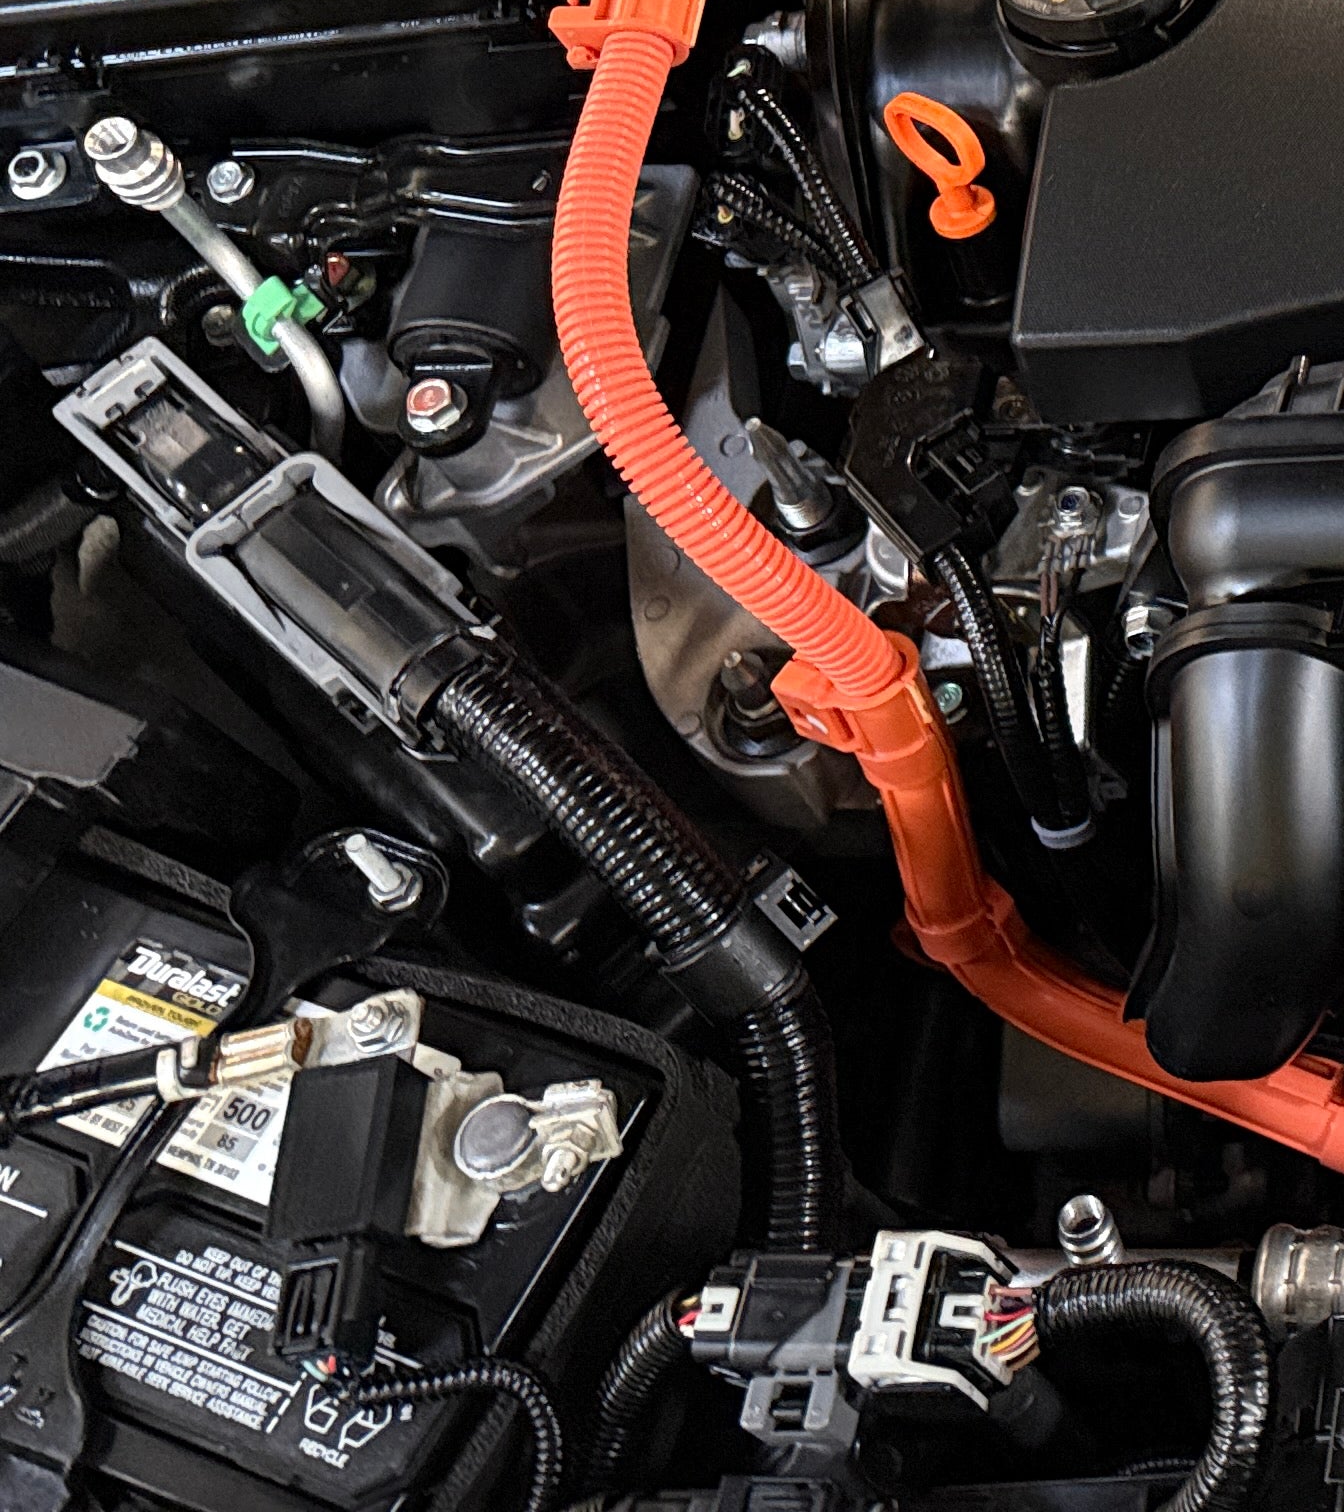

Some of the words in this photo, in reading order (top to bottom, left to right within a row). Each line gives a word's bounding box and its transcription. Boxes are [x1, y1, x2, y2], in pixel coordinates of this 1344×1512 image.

[127, 945, 241, 1008] Duralast
[171, 991, 223, 1017] GOLD
[223, 1097, 271, 1130] 500
[217, 1133, 240, 1152] 85
[156, 1272, 199, 1298] FLUSH
[195, 1287, 229, 1312] EYES
[136, 1304, 188, 1336] MEDICAL
[186, 1325, 221, 1348] HELP
[148, 1289, 180, 1312] WITH
[221, 1318, 251, 1340] GET
[299, 1437, 350, 1470] RECYCLE
